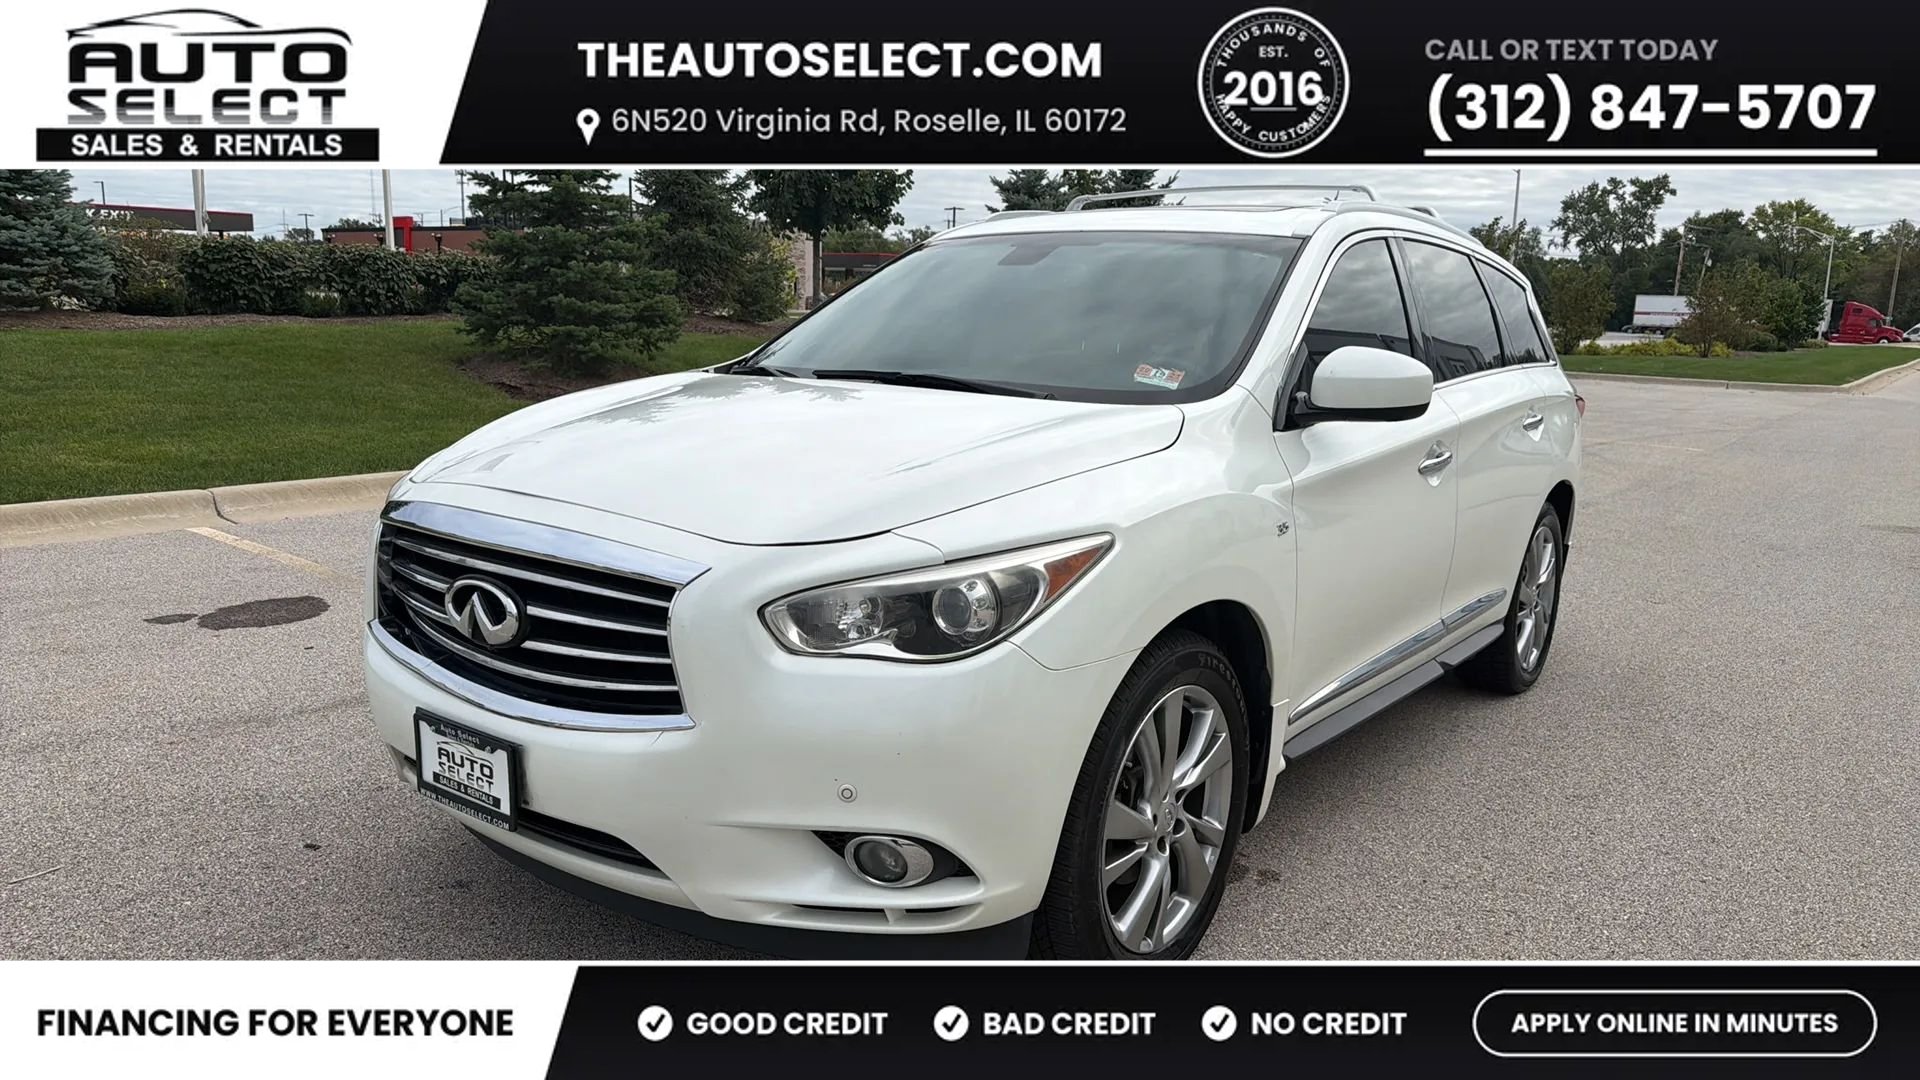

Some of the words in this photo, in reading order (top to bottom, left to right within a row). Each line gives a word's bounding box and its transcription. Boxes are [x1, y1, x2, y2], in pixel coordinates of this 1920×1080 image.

[438, 747, 494, 779] AUTO
[438, 761, 494, 793] SELECT
[439, 777, 459, 789] SALES
[467, 787, 494, 805] RENTALS
[420, 789, 510, 831] WWW.THEAUTOSELECT.COM
